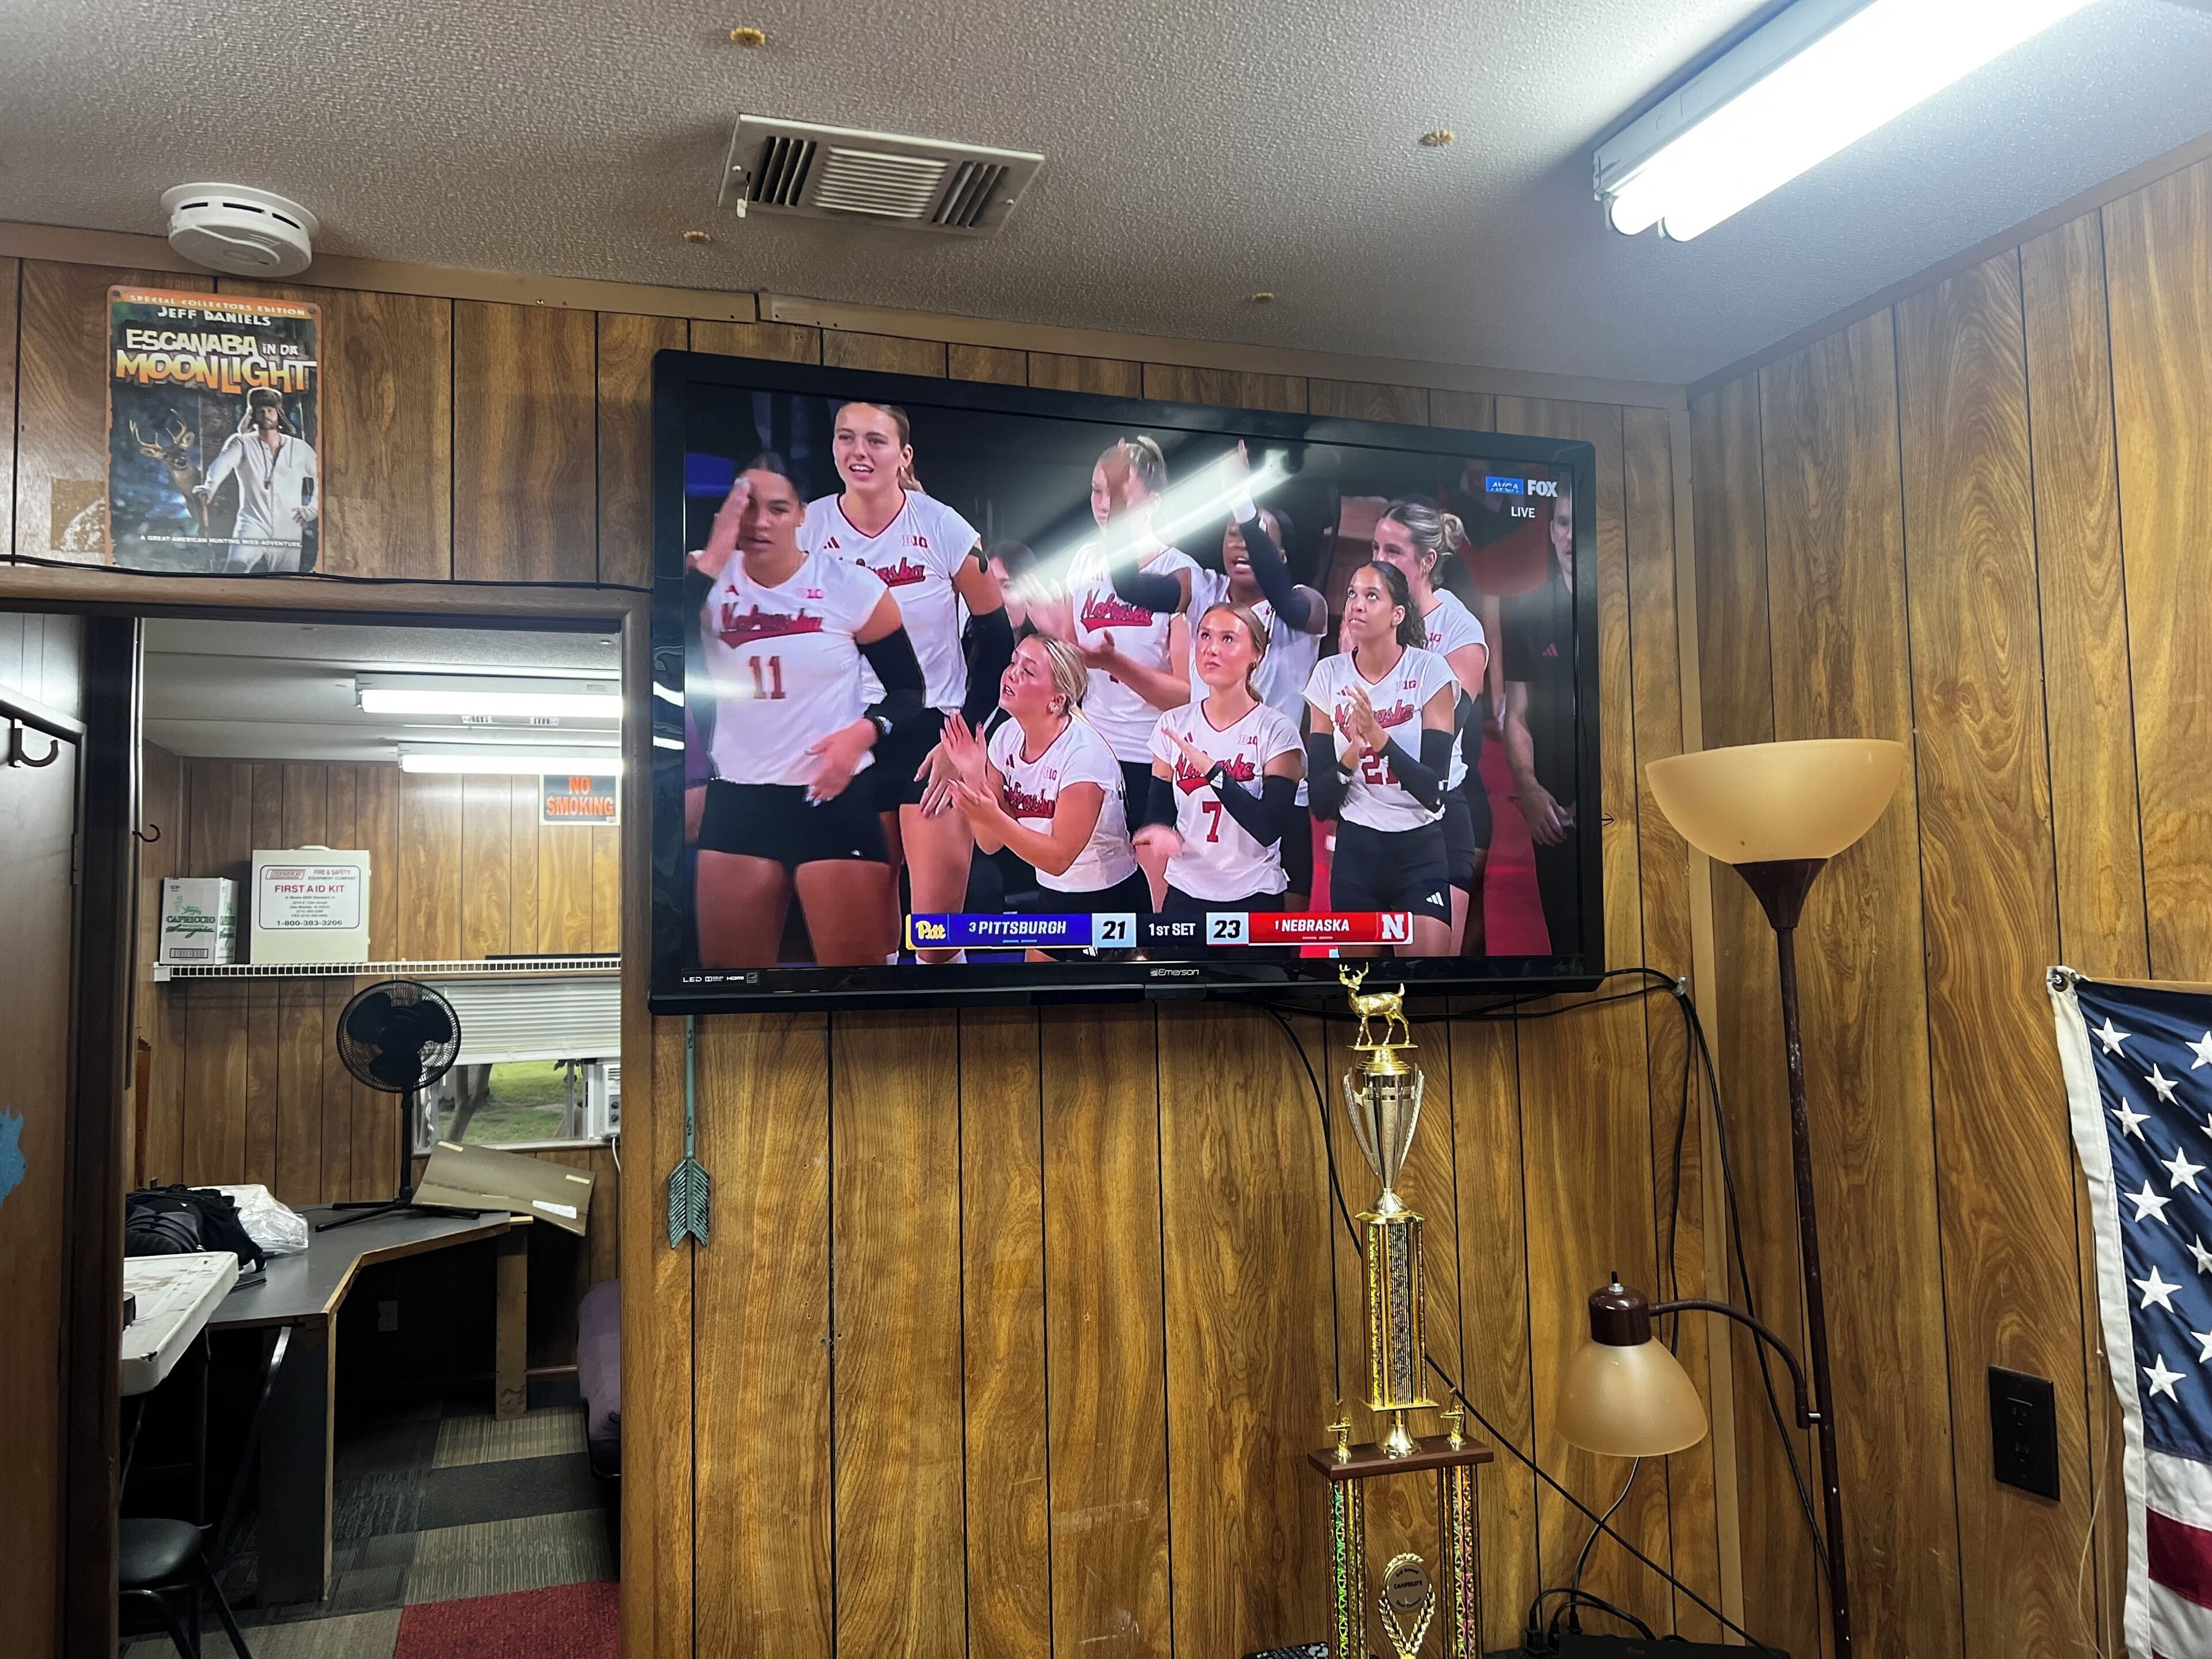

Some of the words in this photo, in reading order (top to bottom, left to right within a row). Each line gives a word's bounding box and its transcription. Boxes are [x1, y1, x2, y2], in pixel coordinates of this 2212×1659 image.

[129, 294, 176, 305] SPECIAL
[181, 299, 252, 311] COLLECTORS
[257, 305, 305, 316] EDITION
[157, 306, 197, 320] JEFF
[203, 309, 271, 327] DANIELS
[126, 328, 259, 357] ESCANABA
[280, 344, 299, 356] DA
[116, 349, 317, 395] MOONLIGHT
[1527, 479, 1558, 498] FOX
[1510, 506, 1536, 518] LIVE
[747, 656, 786, 699] 11
[569, 775, 592, 796] NO
[546, 795, 614, 816] SMOKING
[1202, 801, 1222, 842] 7
[275, 885, 305, 893] FIRST
[306, 885, 325, 893] AID
[328, 885, 345, 893] KIT
[915, 920, 946, 940] Pitt
[968, 922, 977, 933] 3
[978, 921, 1067, 935] PITTSBURGH
[1101, 921, 1126, 940] 21
[1171, 923, 1196, 936] SET
[1213, 919, 1241, 939] 23
[1274, 919, 1279, 930] 1
[1281, 919, 1350, 932] NEBRASKA
[1381, 913, 1406, 940] N
[1157, 968, 1199, 977] Emerson
[1393, 1580, 1423, 1589] CANFIELD'S
